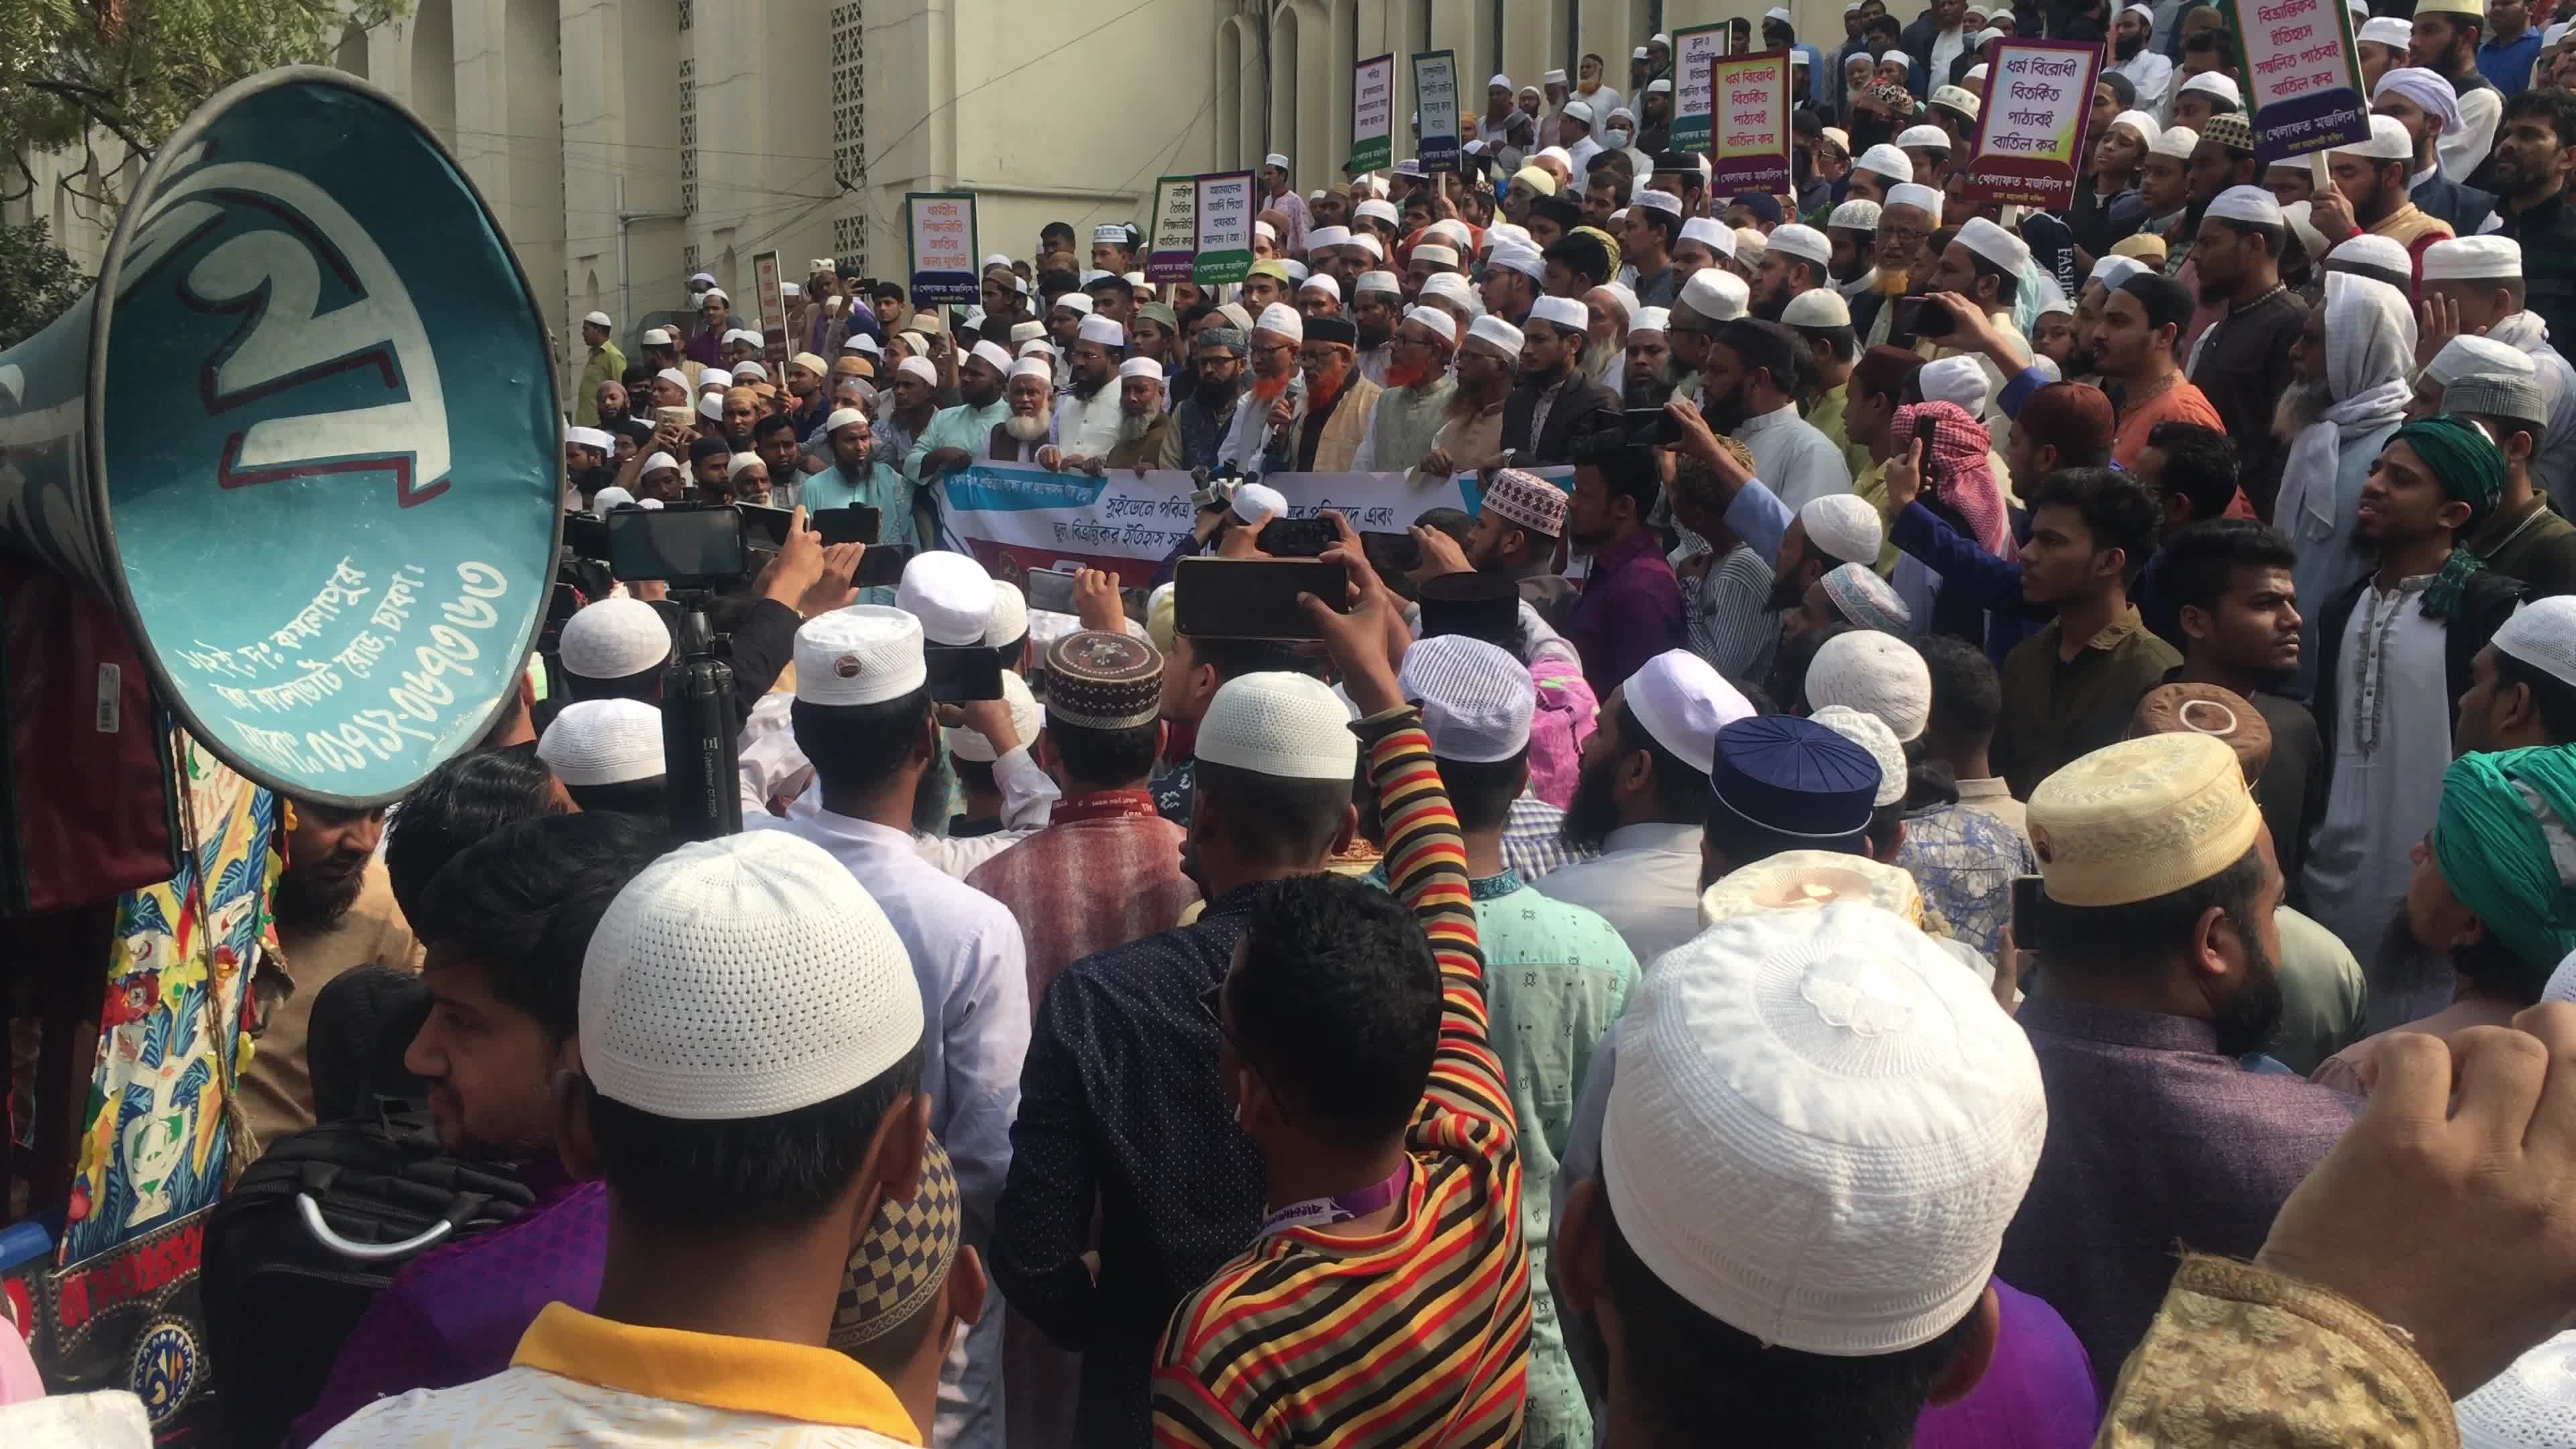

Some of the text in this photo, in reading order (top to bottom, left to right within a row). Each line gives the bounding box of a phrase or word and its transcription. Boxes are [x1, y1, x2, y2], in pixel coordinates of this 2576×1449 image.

[2270, 25, 2312, 46] ইতিহাস
[2006, 57, 2077, 77] ধর্ম বিরোধী
[2255, 54, 2297, 74] সম্বলিত
[1690, 68, 1711, 80] ইতিহা
[1725, 66, 1776, 85] ধর্ম বিরোধী
[2270, 71, 2333, 95] বাতিল কর
[1732, 89, 1769, 105] বিতর্কিত
[2010, 81, 2062, 101] বিতর্কিত
[1733, 110, 1766, 126] পাঠ্যবই
[2008, 107, 2054, 128] পাঠ্যবই
[2267, 109, 2356, 141] খেলাফত মজলিস
[1727, 131, 1774, 146] বাতিল কর
[1992, 132, 2059, 153] বাতিল কর
[1721, 167, 1782, 182] খেলাফত মজলিস
[1978, 174, 2063, 192] খেলাফত মজলিস
[1209, 184, 1241, 194] আমাদের
[1208, 198, 1244, 211] আদি পিতা
[1213, 217, 1238, 227] হযরত
[1159, 234, 1193, 246] বাতিল কর
[1203, 235, 1224, 244] আদম
[1106, 494, 1191, 518] সুইডেনে পবিত্র
[1364, 508, 1393, 526] এবং
[1072, 519, 1121, 546] বিভ্রান্তিকর
[1123, 523, 1165, 549] ইতিহাস
[269, 556, 370, 649] কমলাপুর
